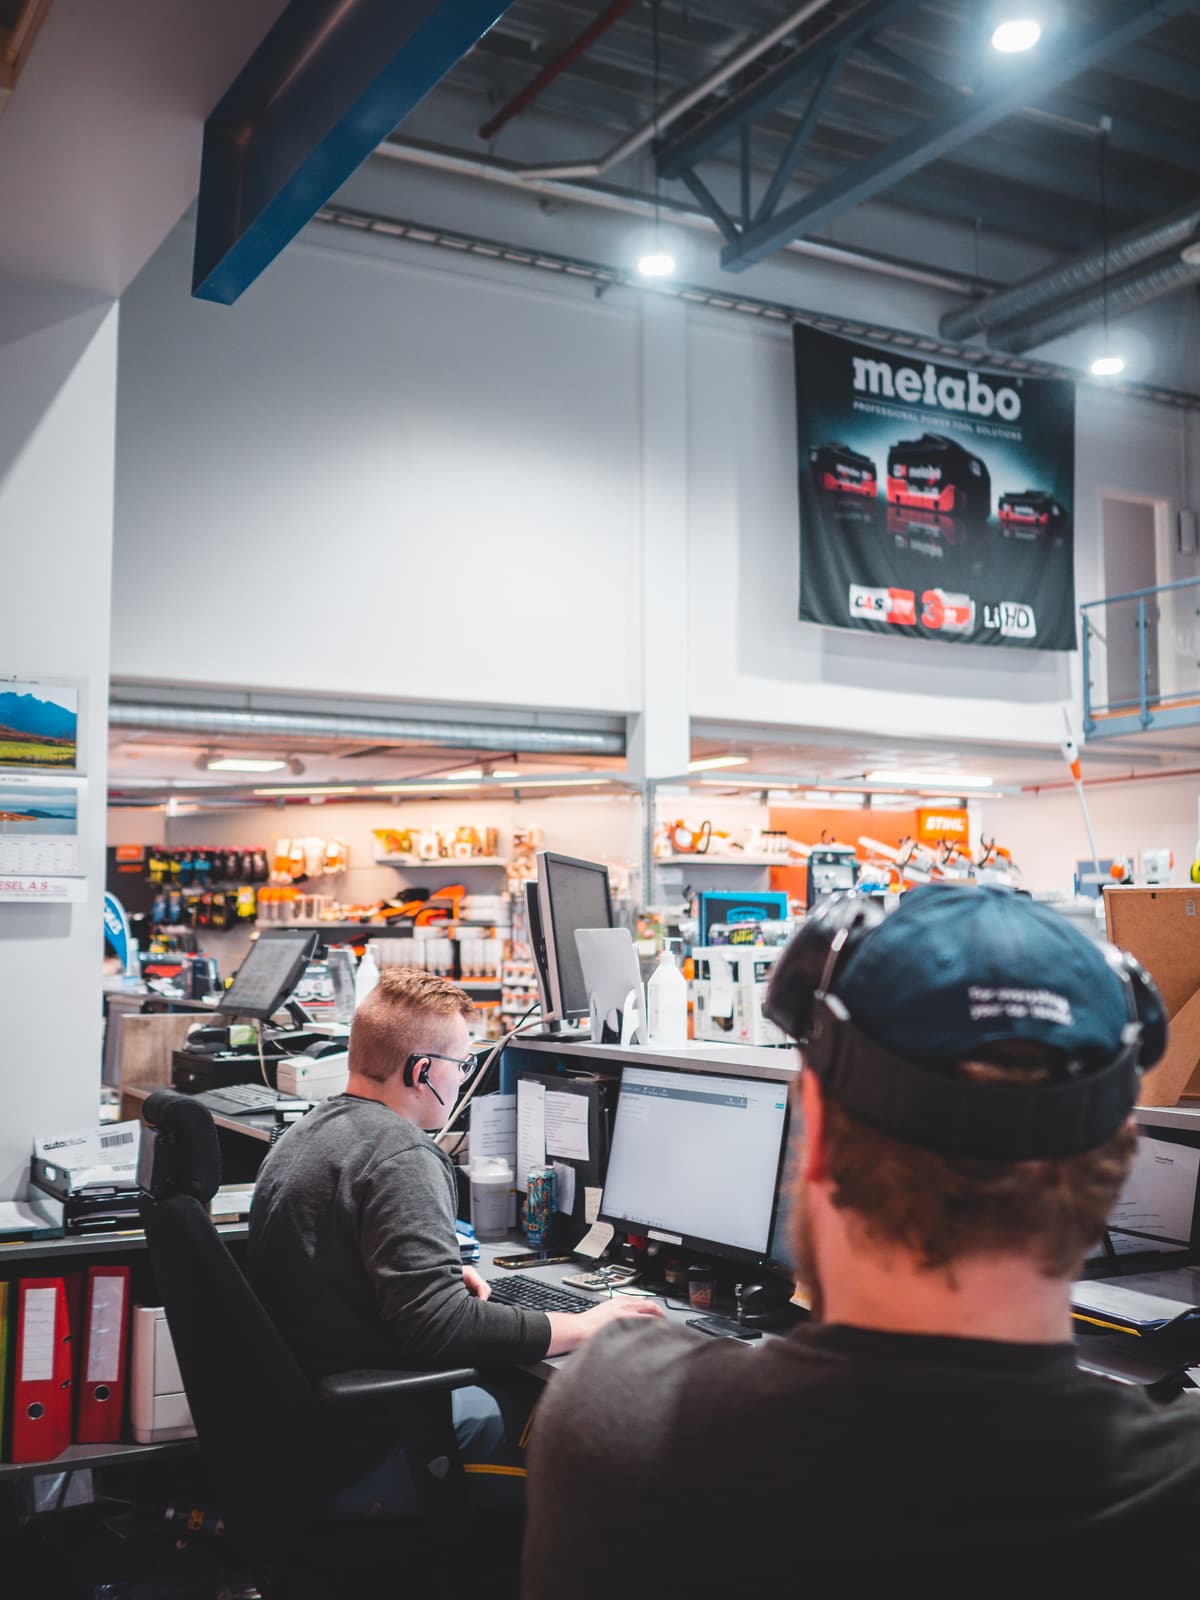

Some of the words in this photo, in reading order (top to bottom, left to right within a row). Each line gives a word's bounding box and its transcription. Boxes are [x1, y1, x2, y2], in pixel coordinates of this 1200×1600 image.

[853, 357, 1021, 421] metabo
[853, 401, 918, 421] PROFESSIONAL
[920, 415, 950, 428] POWER
[976, 426, 1023, 441] SOLUTIONS
[855, 595, 884, 611] CAS
[921, 590, 944, 629] 3
[926, 815, 964, 832] STIHL
